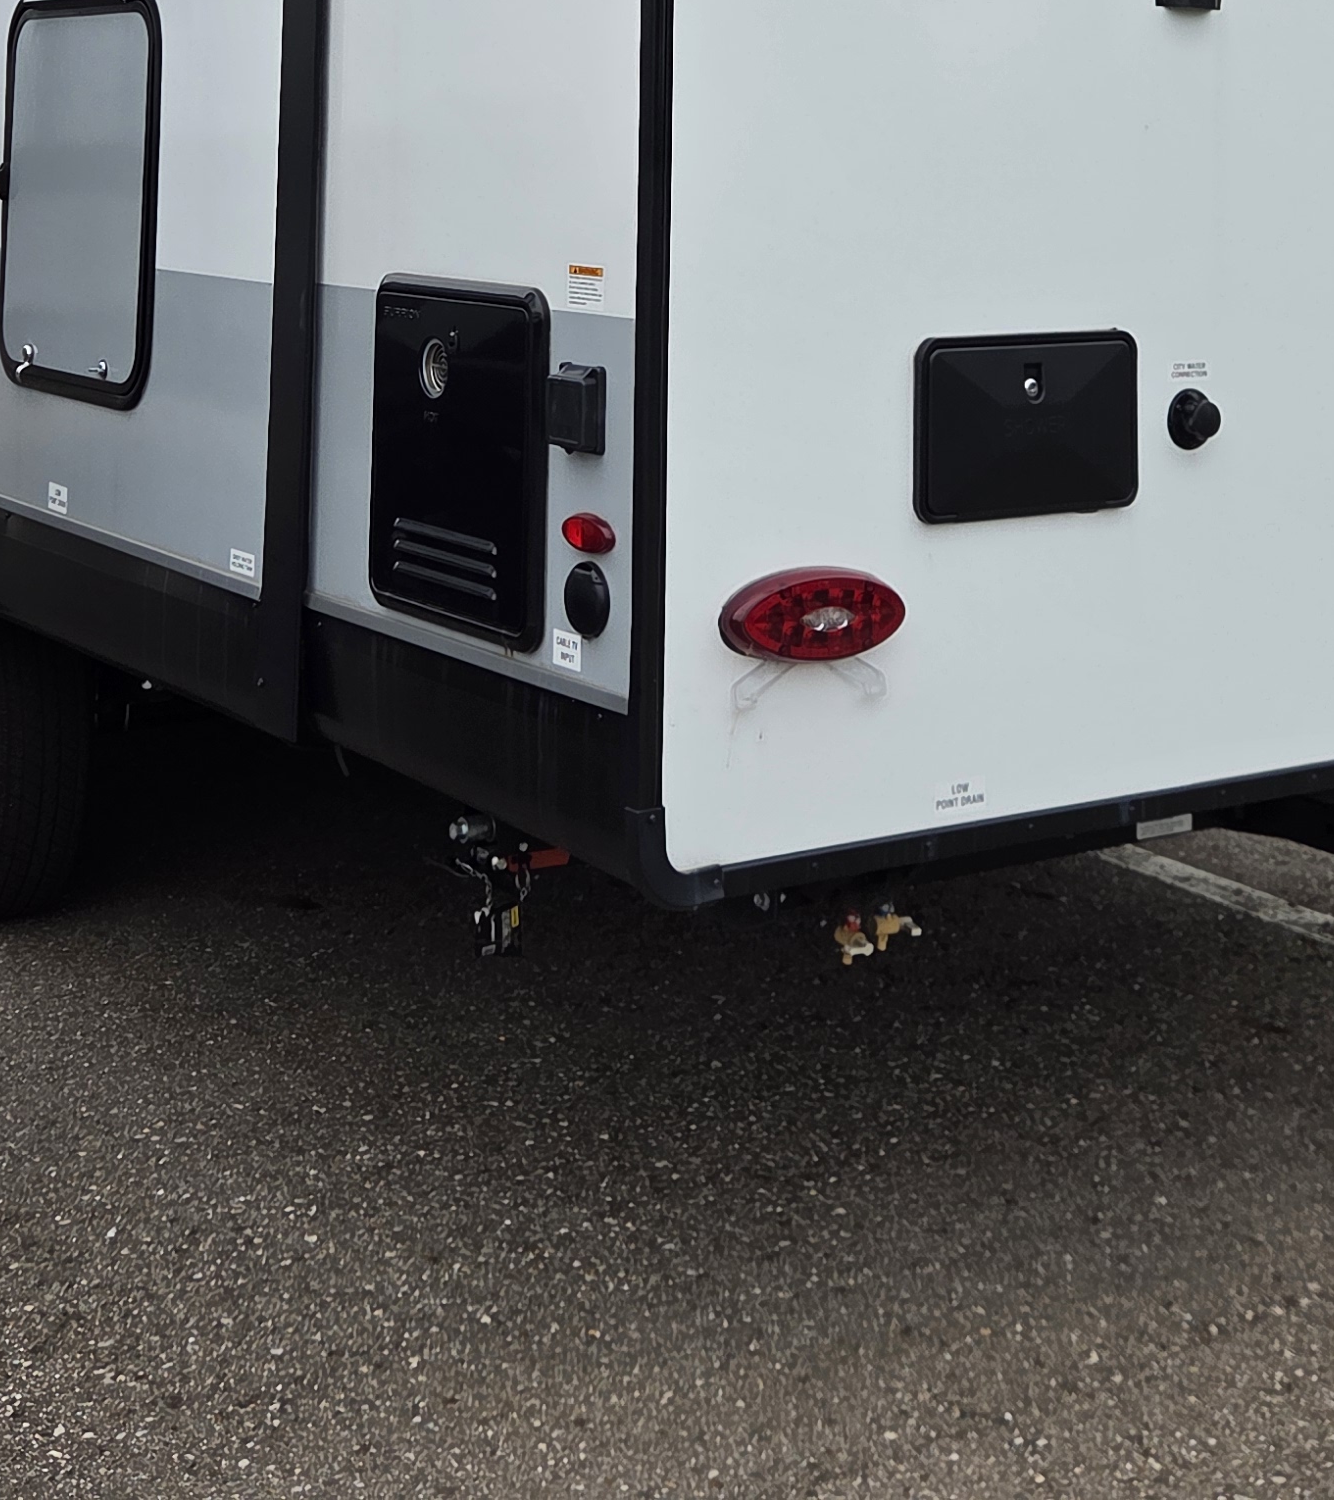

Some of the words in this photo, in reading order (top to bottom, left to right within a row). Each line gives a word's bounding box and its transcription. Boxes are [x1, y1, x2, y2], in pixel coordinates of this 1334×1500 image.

[951, 782, 970, 795] LOW
[936, 796, 959, 811] POINT
[960, 793, 984, 807] DRAIN
